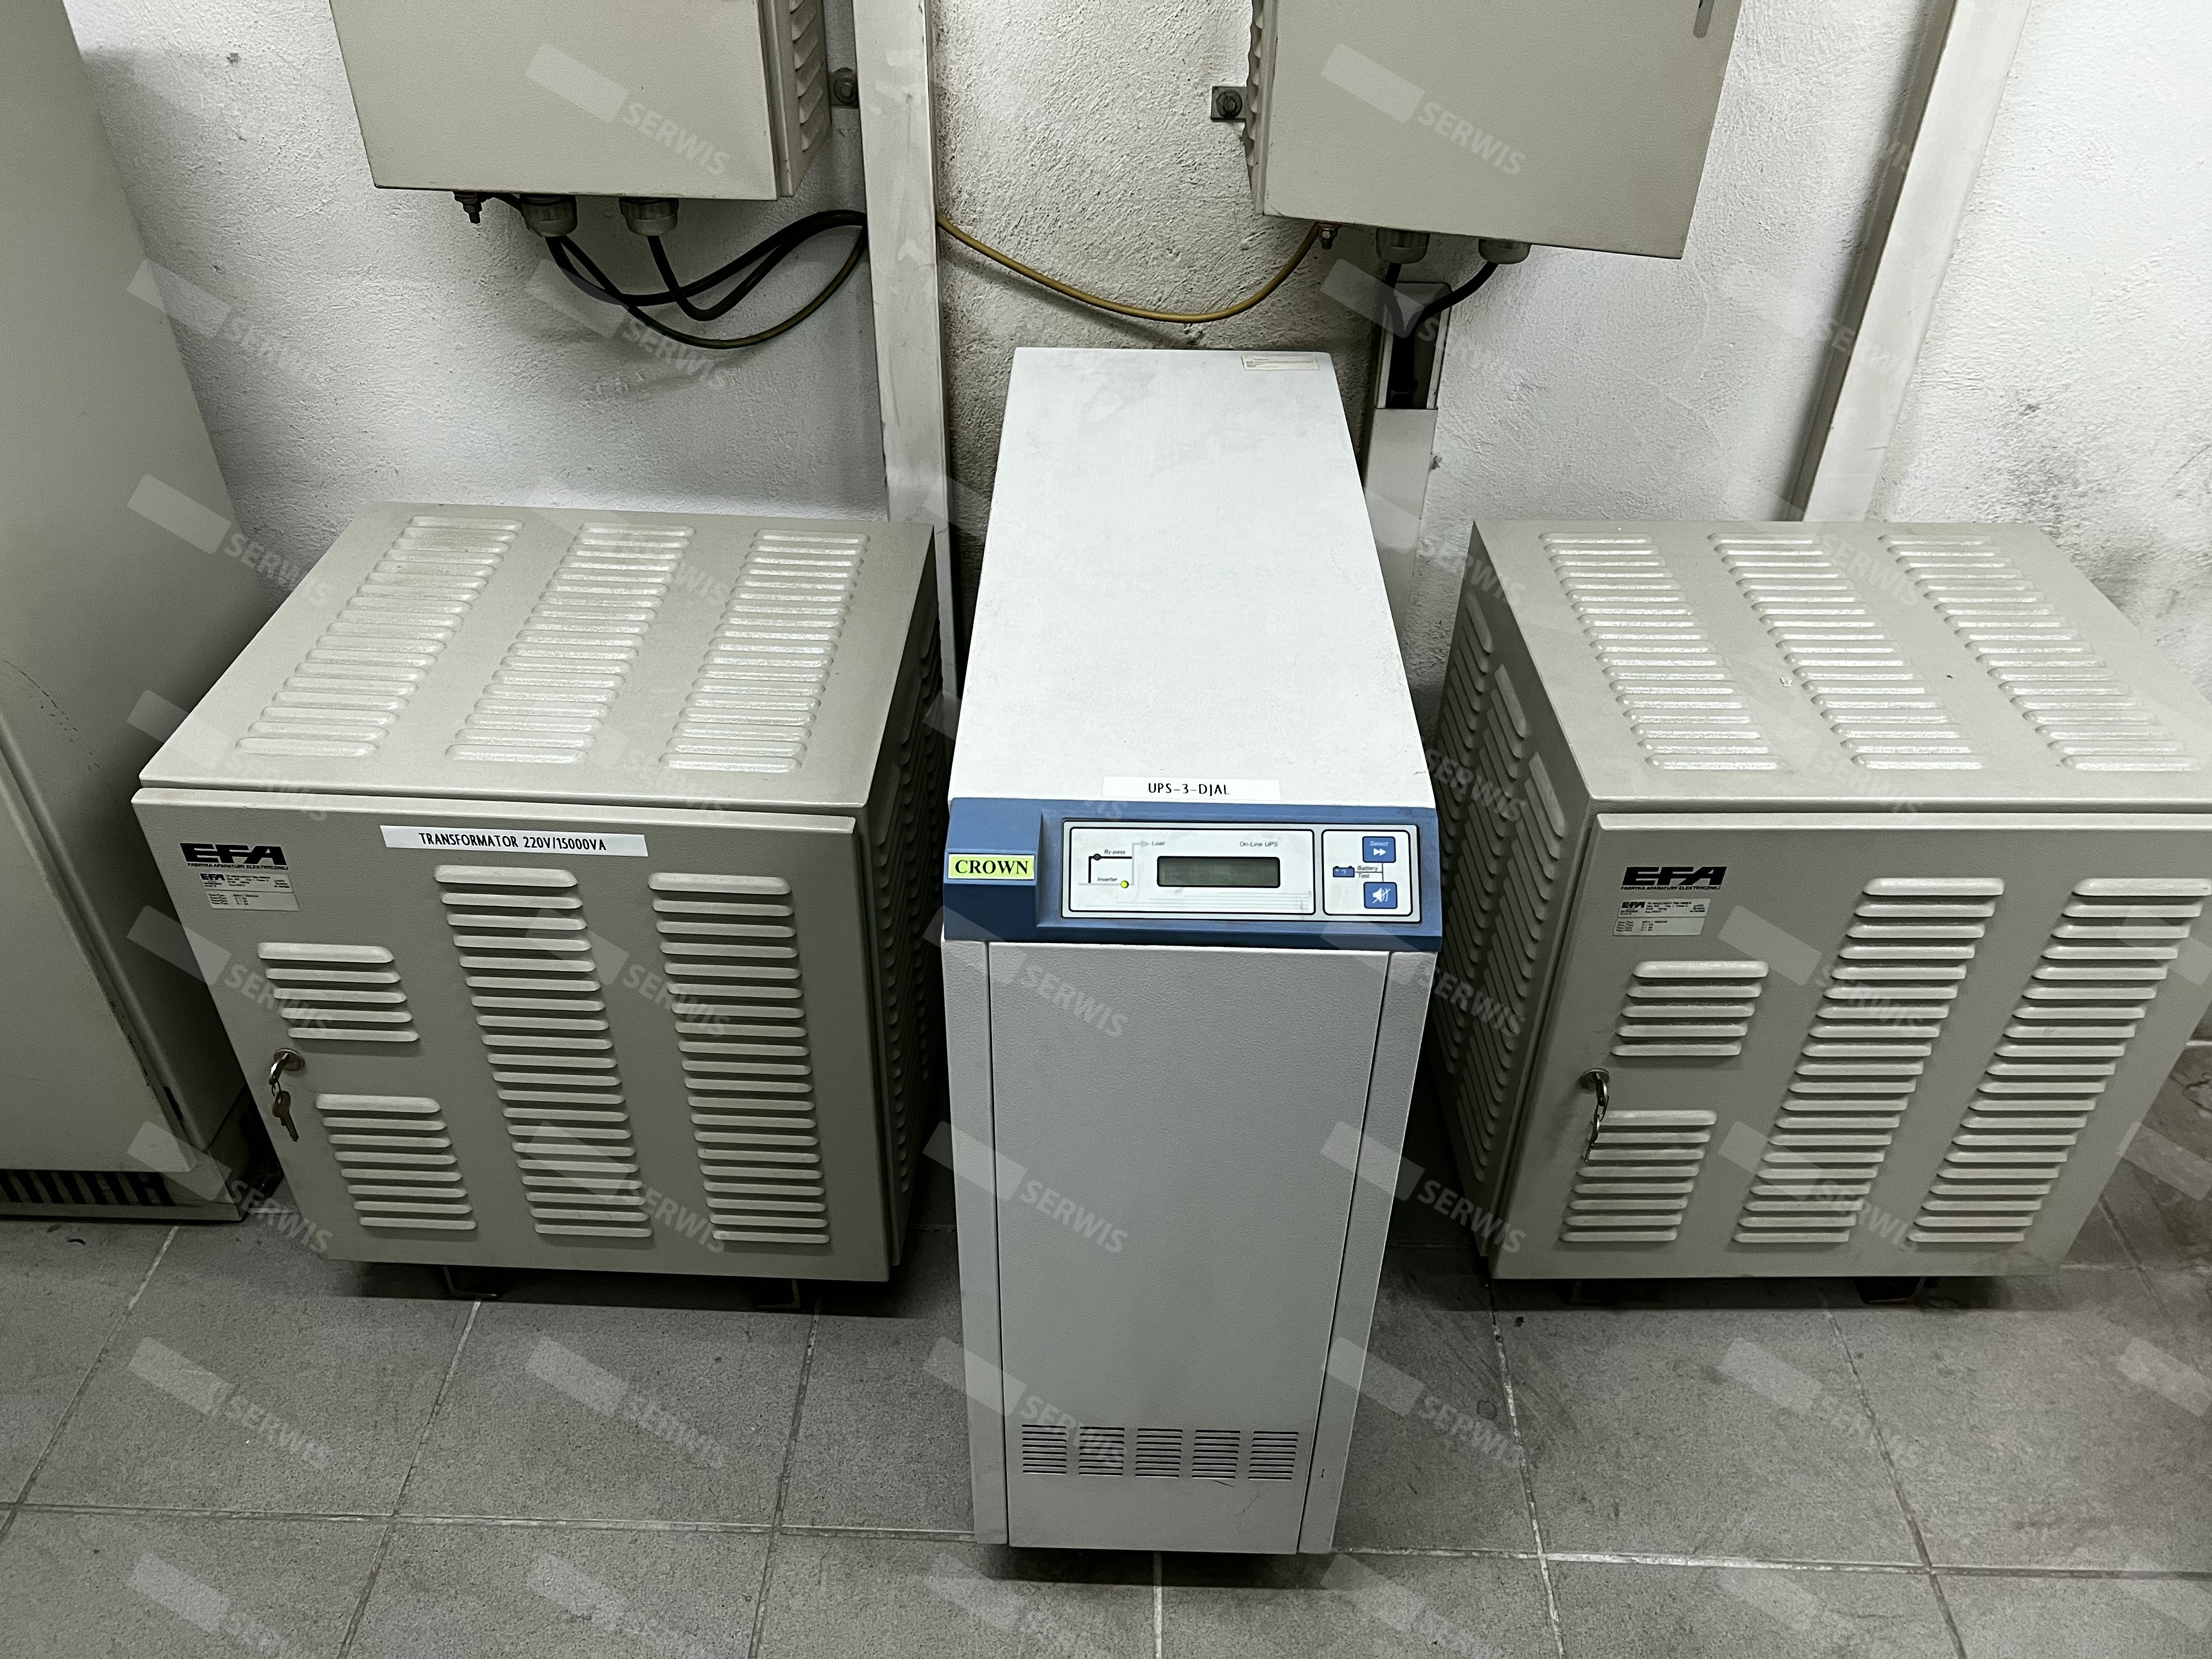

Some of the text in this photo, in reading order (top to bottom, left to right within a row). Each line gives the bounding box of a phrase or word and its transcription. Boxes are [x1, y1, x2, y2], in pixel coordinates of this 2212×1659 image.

[1148, 783, 1230, 797] UPS-3-DJAL
[419, 833, 607, 851] TRANSFORMATOR 220V/15000VA
[180, 843, 287, 865] EFA
[955, 860, 1029, 874] CROWN
[1622, 867, 1727, 885] EFA
